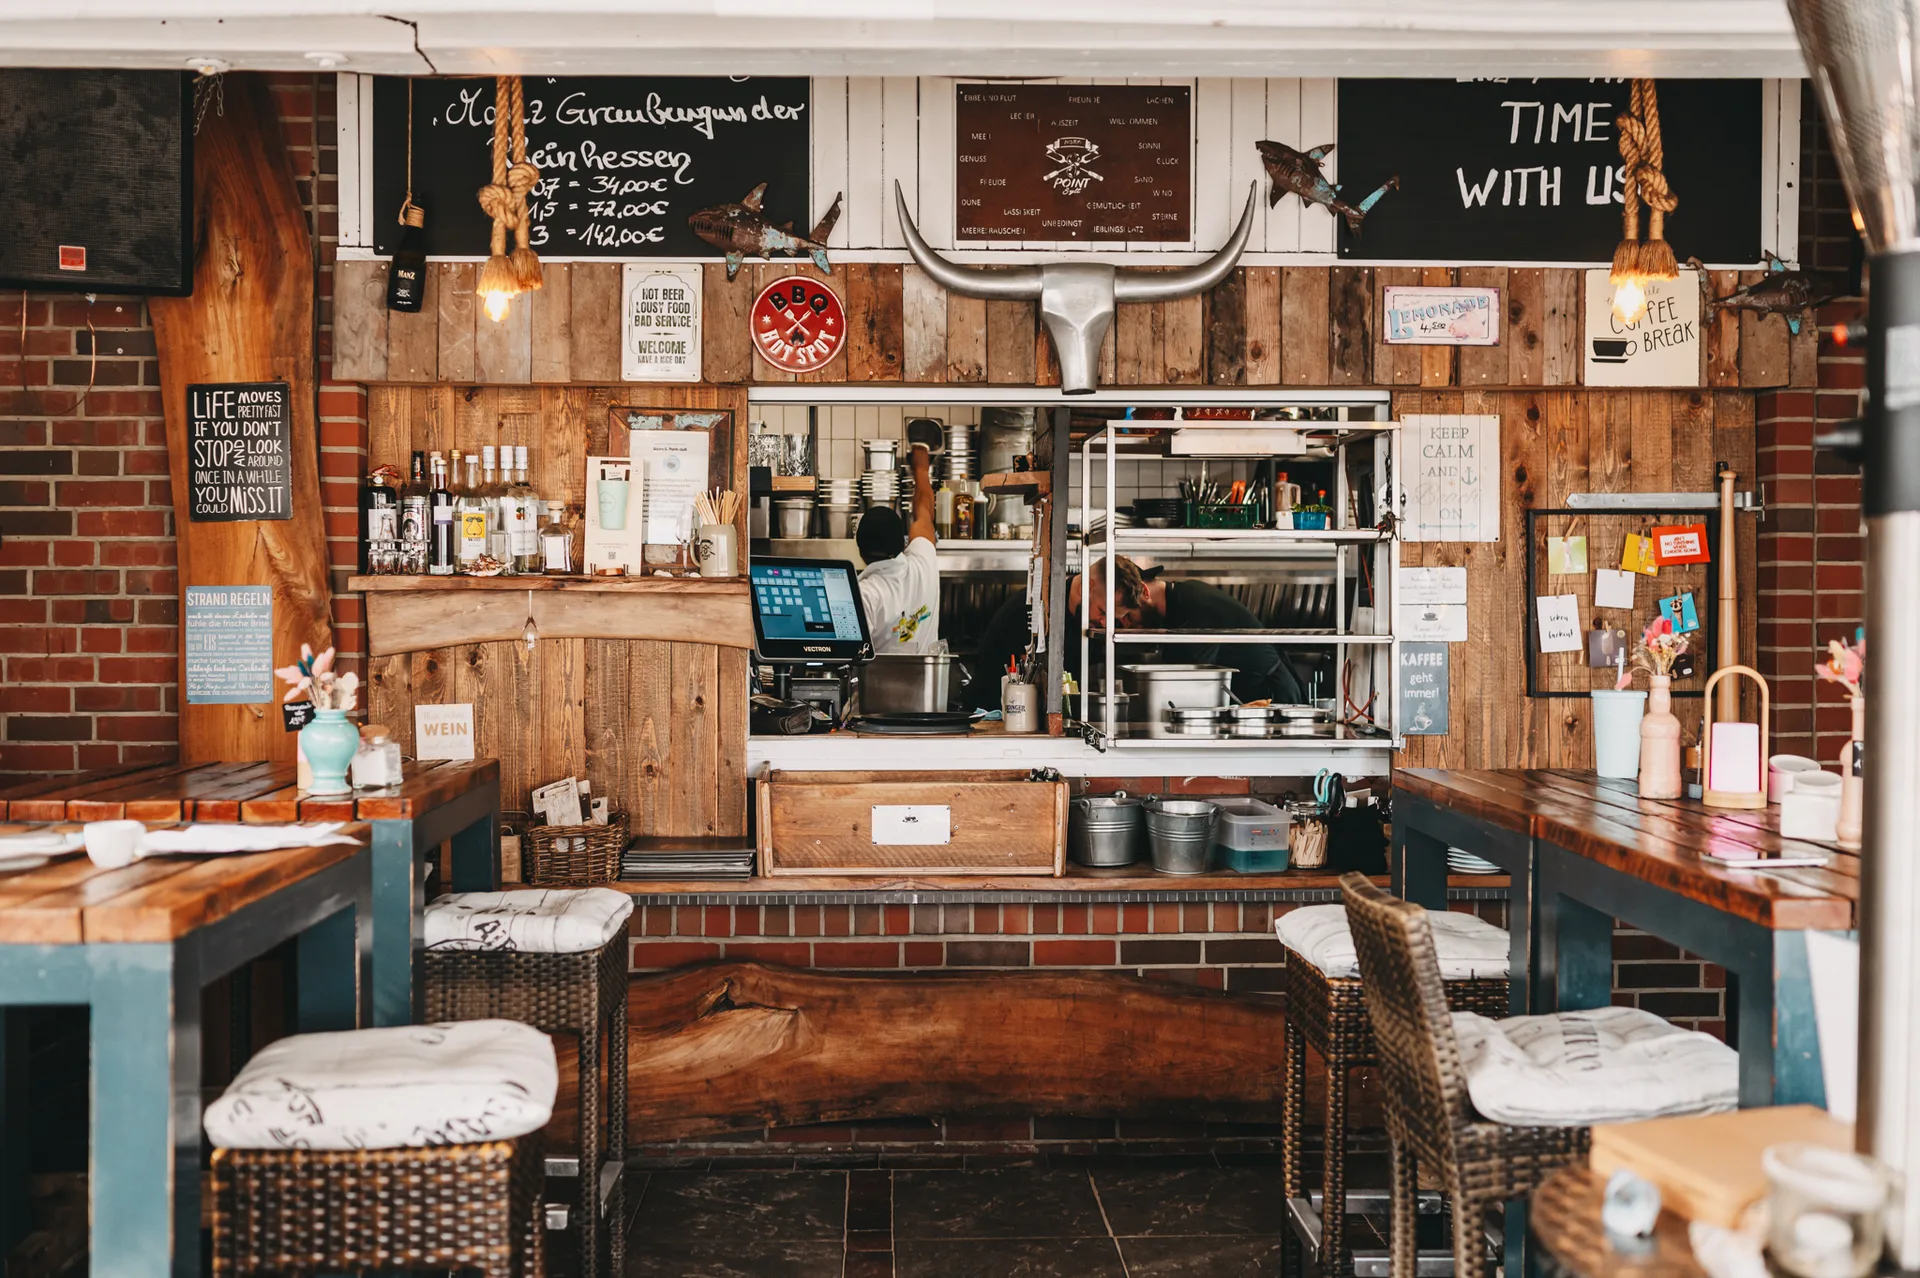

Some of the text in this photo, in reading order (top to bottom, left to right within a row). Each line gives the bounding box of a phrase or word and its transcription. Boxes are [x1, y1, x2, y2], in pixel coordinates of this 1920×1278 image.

[445, 87, 546, 127] Maz
[1501, 101, 1612, 144] TIME
[960, 155, 987, 163] GENUSS
[588, 176, 667, 195] 34,00€
[1053, 177, 1091, 189] POINT
[1456, 165, 1641, 209] WITH US
[1062, 187, 1082, 196] Sylt
[1153, 189, 1173, 197] WND
[528, 201, 558, 221] 1,5
[588, 200, 669, 218] 72,00€
[1042, 219, 1083, 227] UNBEDINGT
[1091, 225, 1144, 233] IEBLINGSLATZ
[529, 225, 550, 245] 3
[578, 223, 665, 247] 142,00€
[397, 269, 416, 280] MANZ
[642, 288, 684, 301] HOT BEER
[768, 285, 829, 318] BBQ
[636, 301, 690, 314] LOUSY FOOD
[634, 314, 691, 328] BAD SERVICE
[1388, 295, 1489, 339] LEMONADE
[1610, 296, 1678, 335] CfEE
[638, 340, 686, 355] WELCOME
[760, 328, 836, 365] HOT SPOT
[637, 355, 652, 364] HAVE
[654, 355, 659, 364] A
[674, 356, 686, 364] DAY
[237, 391, 282, 404] MOVES
[237, 404, 282, 419] PRETTY FAST
[194, 421, 282, 437] IF YOU DON'T
[1430, 426, 1470, 440] KEEP
[194, 440, 234, 468] STOP
[233, 440, 246, 467] AND
[247, 440, 283, 454] LOOK
[1422, 444, 1475, 459] CALM
[247, 455, 283, 468] AROUND
[195, 470, 282, 485] ONCE IN A WHILE
[1427, 466, 1459, 478] AND
[195, 486, 228, 504] YOU
[267, 486, 284, 514] IT
[196, 503, 229, 514] COULD
[1439, 508, 1463, 521] ON
[187, 592, 270, 606] STRAND REGELN
[1400, 652, 1443, 667] KAFFEE
[1409, 671, 1433, 686] geht
[1404, 687, 1439, 699] immer!
[424, 722, 468, 736] WEIN
